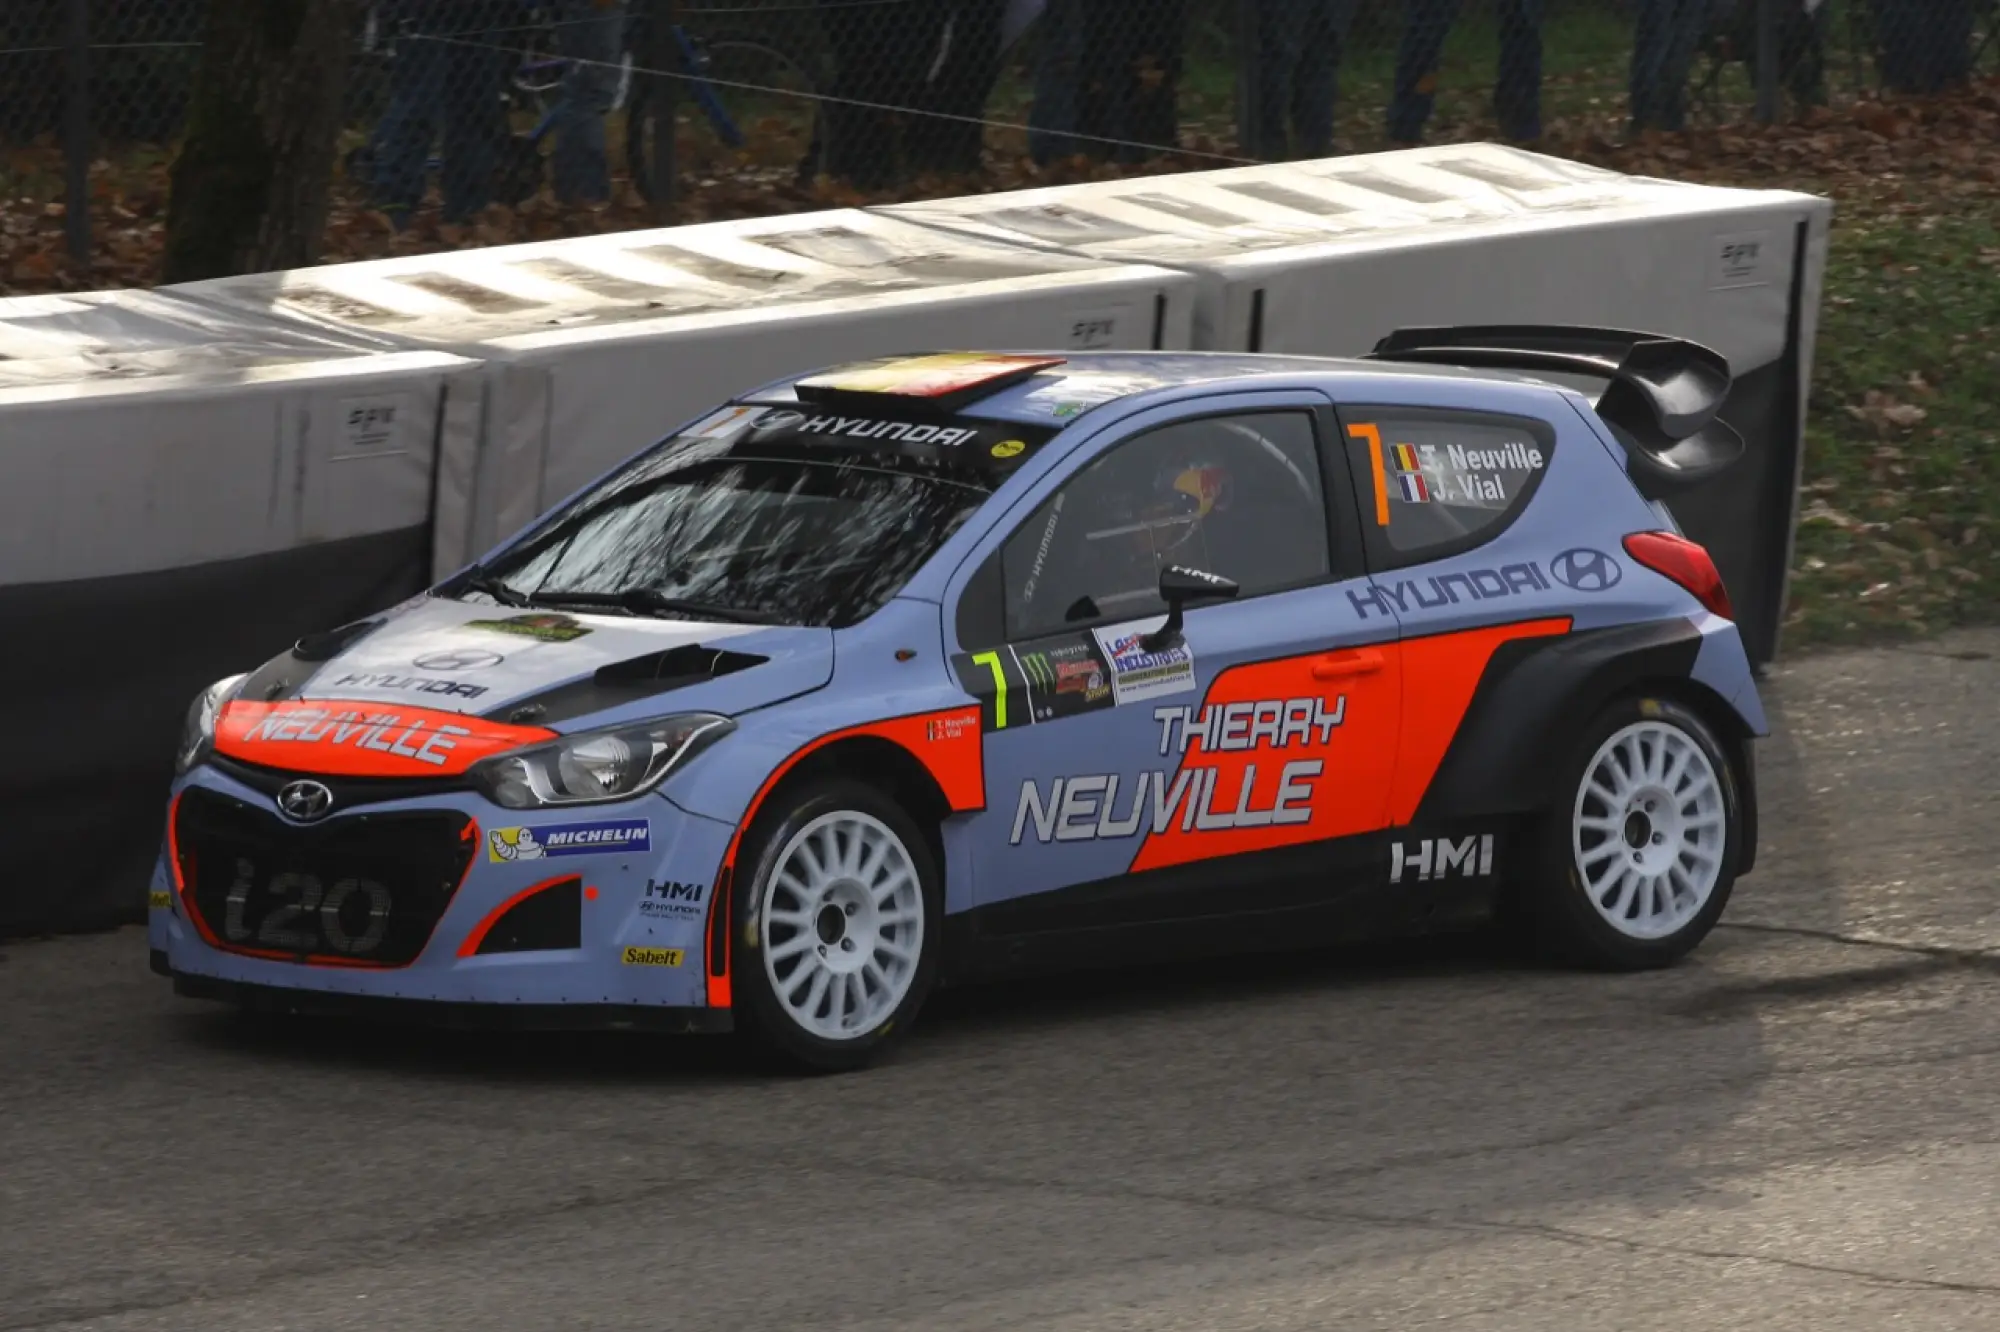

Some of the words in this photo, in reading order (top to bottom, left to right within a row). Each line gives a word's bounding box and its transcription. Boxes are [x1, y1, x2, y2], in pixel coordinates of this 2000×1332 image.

[797, 414, 978, 447] HYUNDAI
[1420, 443, 1444, 472] T.
[1446, 442, 1544, 472] Neuville
[1346, 423, 1390, 527] 7
[1432, 474, 1454, 500] J.
[1457, 473, 1506, 501] Vial
[1032, 512, 1059, 577] HYUNDAI
[1345, 561, 1552, 620] HYUNDAI
[334, 673, 489, 700] HYUNDAI
[971, 649, 1007, 729] 7
[243, 708, 471, 766] NEUVILLE
[1152, 695, 1345, 757] THIERRY
[1008, 759, 1324, 847] NEUVILLE
[547, 826, 648, 846] MICHELIN
[1389, 833, 1494, 884] HMI
[224, 857, 392, 953] i20
[645, 879, 704, 902] HMI
[626, 947, 678, 966] Sabelt
